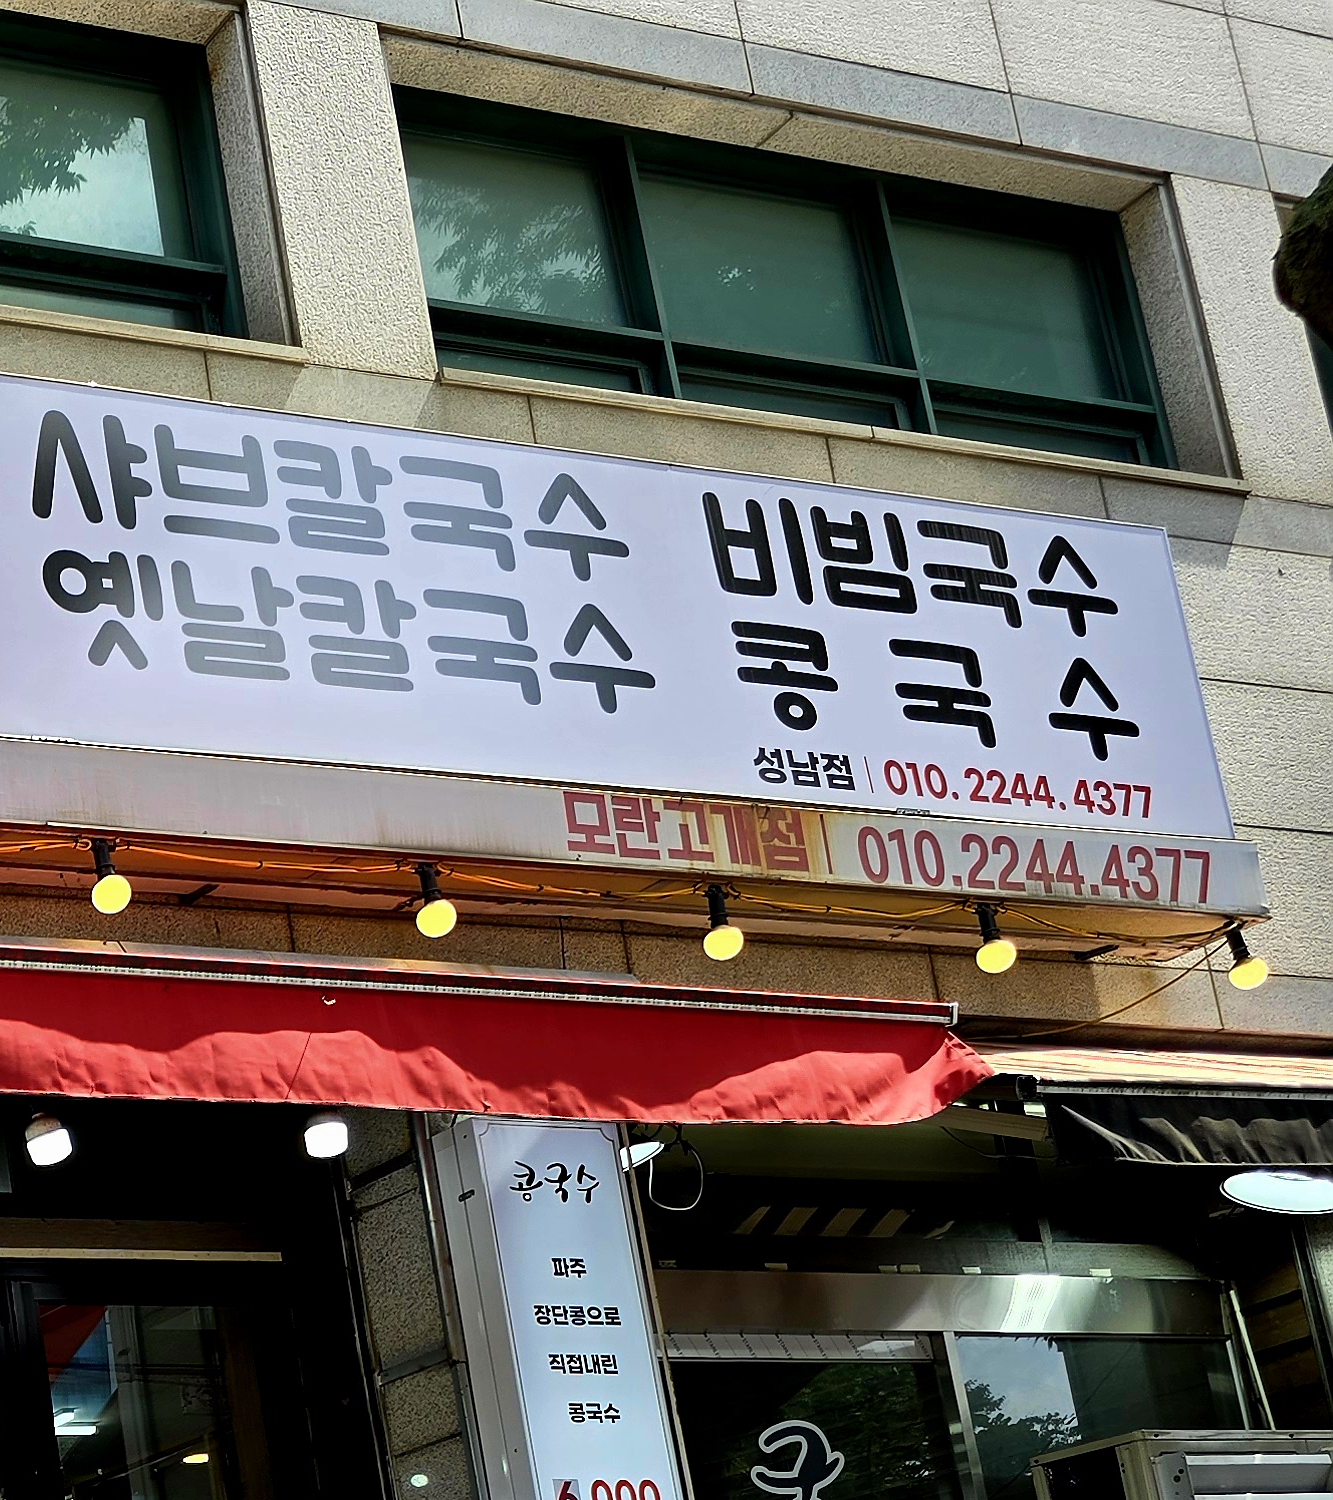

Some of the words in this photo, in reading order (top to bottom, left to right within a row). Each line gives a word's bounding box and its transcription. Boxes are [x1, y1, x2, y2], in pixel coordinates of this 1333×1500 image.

[32, 409, 630, 582] 샤브칼국수
[702, 491, 1119, 638] 비빔국수
[42, 549, 656, 714] 옛날칼국수
[753, 746, 856, 792] 성남점
[563, 790, 810, 872] 모란고개점
[857, 825, 1211, 904] 010.2244.4377
[509, 1160, 600, 1203] 콩국수
[551, 1257, 587, 1278] 파주
[533, 1304, 622, 1327] 장단콩으로
[547, 1353, 619, 1375] 직접내린
[567, 1402, 622, 1424] 콩국수
